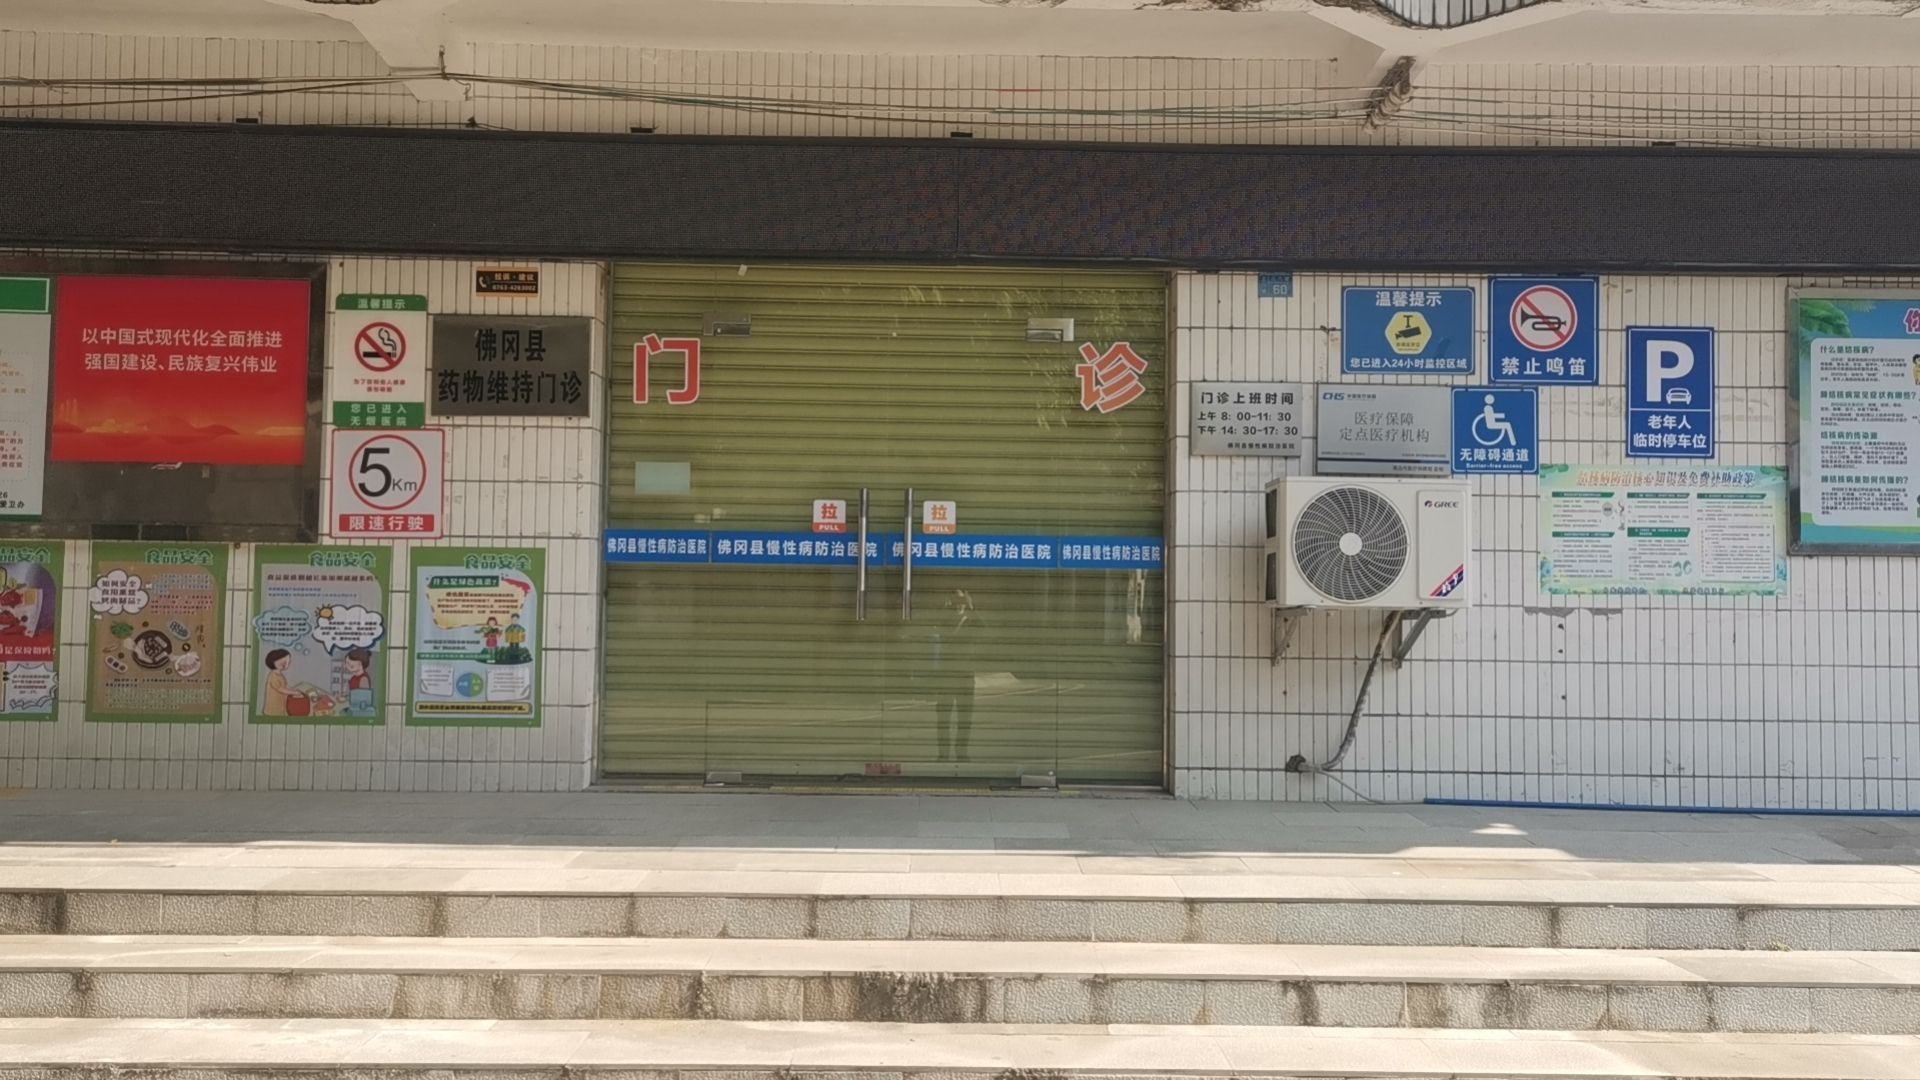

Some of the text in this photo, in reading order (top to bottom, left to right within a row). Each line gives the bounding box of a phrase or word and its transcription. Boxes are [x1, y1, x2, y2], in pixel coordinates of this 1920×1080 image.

[1272, 284, 1288, 295] 60
[357, 298, 406, 309] 温馨提示
[1375, 290, 1442, 307] 温馨提示
[81, 327, 283, 348] 以中国式现代化全面推进
[475, 328, 546, 362] 佛冈县
[84, 352, 278, 374] 强国建设、民族复兴伟业
[1350, 357, 1468, 370] 您已进入24小时监控区域
[1501, 357, 1587, 376] 禁止鸣笛
[1646, 339, 1694, 402] P
[633, 333, 1147, 413] 门 诊
[438, 370, 582, 405] 药物维持门诊
[1200, 391, 1295, 405] 门诊上班时间
[351, 403, 407, 414] 您已进入
[1197, 411, 1217, 421] 上午
[350, 416, 407, 427] 无烟医院
[1354, 410, 1415, 425] 医疗保障
[1648, 414, 1692, 430] 老年人
[1197, 426, 1217, 436] 下午
[1339, 427, 1430, 443] 定点医疗机构
[1633, 432, 1708, 449] 临时停车位
[1459, 448, 1529, 462] 无障碍通道
[821, 503, 838, 519] 拉
[930, 504, 948, 521] 拉
[349, 516, 424, 531] 限速行驶
[607, 537, 707, 555] 佛冈县慢性病防治医院
[717, 539, 878, 557] 佛冈县慢性病防治医院
[892, 541, 1052, 560] 佛冈县慢性病防治医院
[1062, 544, 1161, 561] 佛冈县慢性病防治医院
[146, 548, 213, 564] 食品安全
[309, 552, 376, 568] 食品安全
[464, 553, 530, 570] 食品安全
